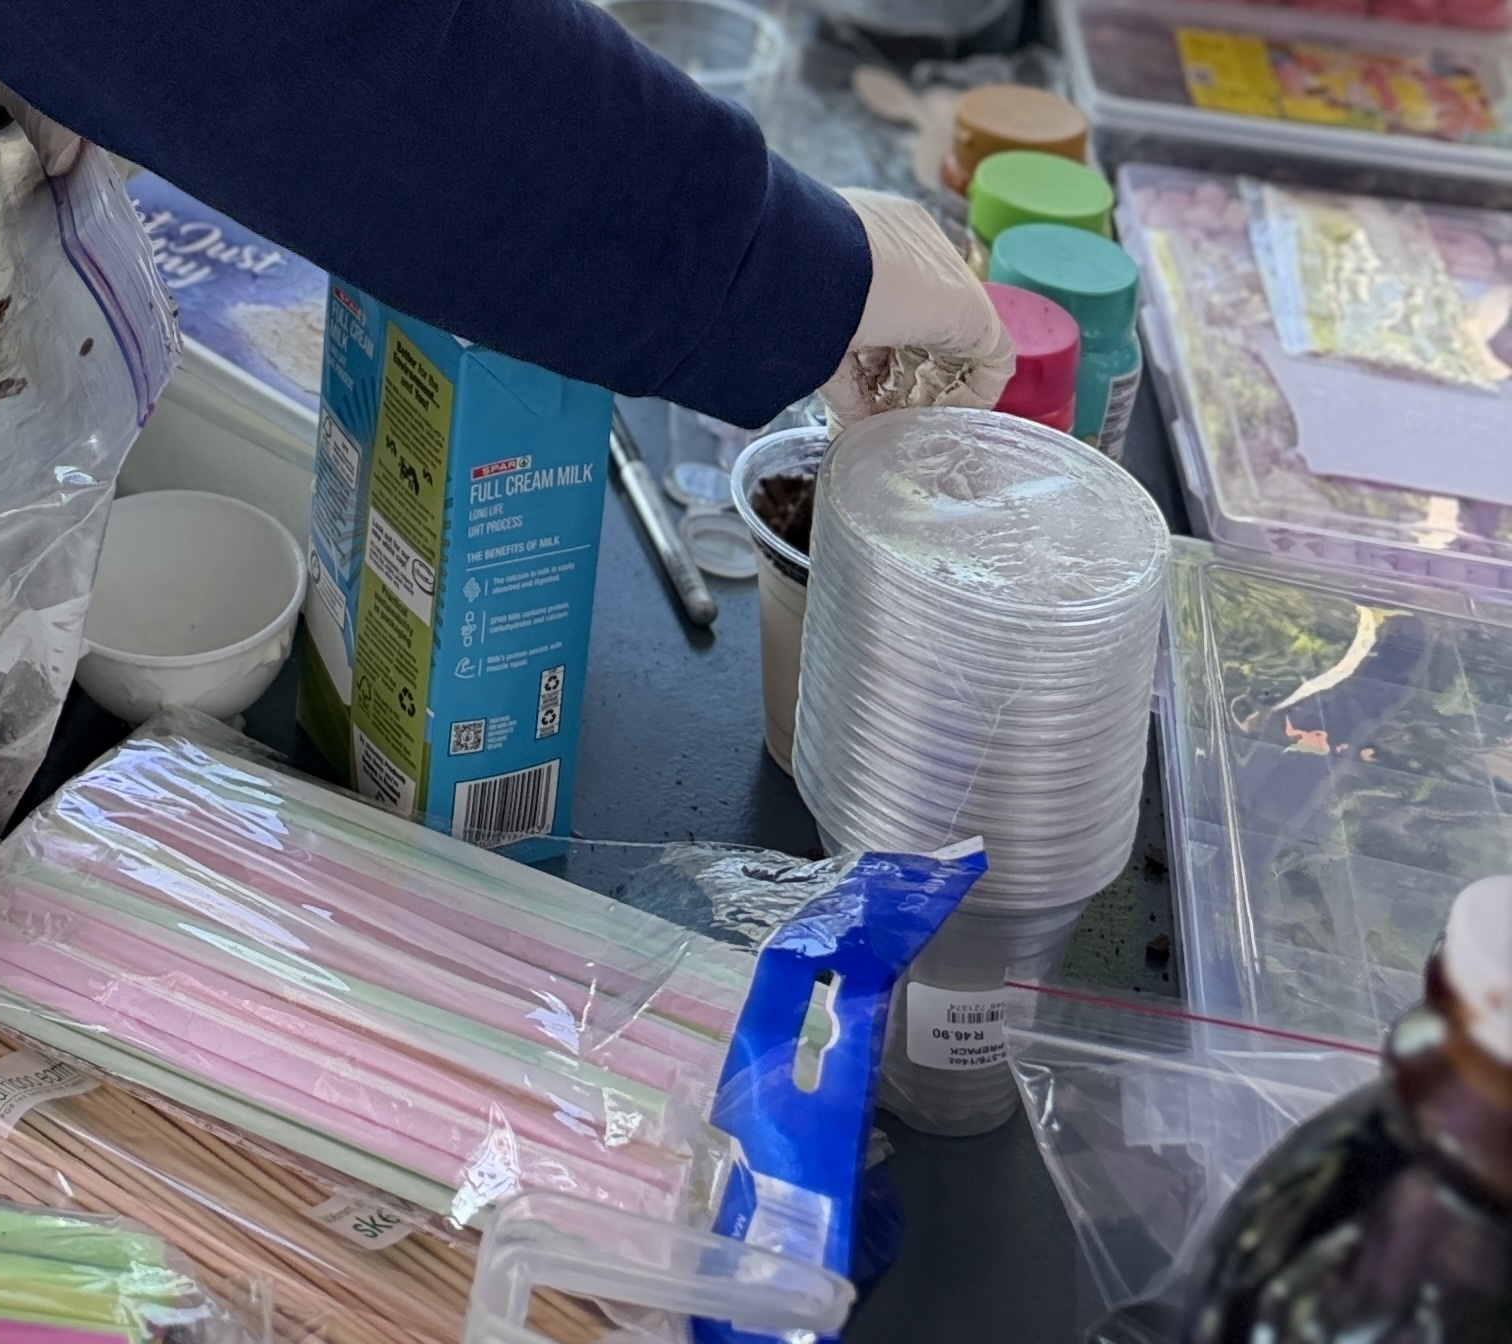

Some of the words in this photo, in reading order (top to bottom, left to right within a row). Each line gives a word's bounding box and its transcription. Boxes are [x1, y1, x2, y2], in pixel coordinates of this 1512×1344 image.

[168, 221, 288, 275] Just
[350, 318, 375, 361] CREAM
[481, 458, 518, 476] SPAR
[469, 478, 503, 505] FULL
[505, 467, 555, 497] CREAM
[556, 462, 594, 487] MILK
[468, 505, 489, 522] LONG
[485, 514, 524, 535] PROCESS
[466, 550, 484, 564] THE
[484, 542, 525, 561] BENEFITS
[526, 539, 538, 552] OF
[949, 1042, 1005, 1055] PREPACK
